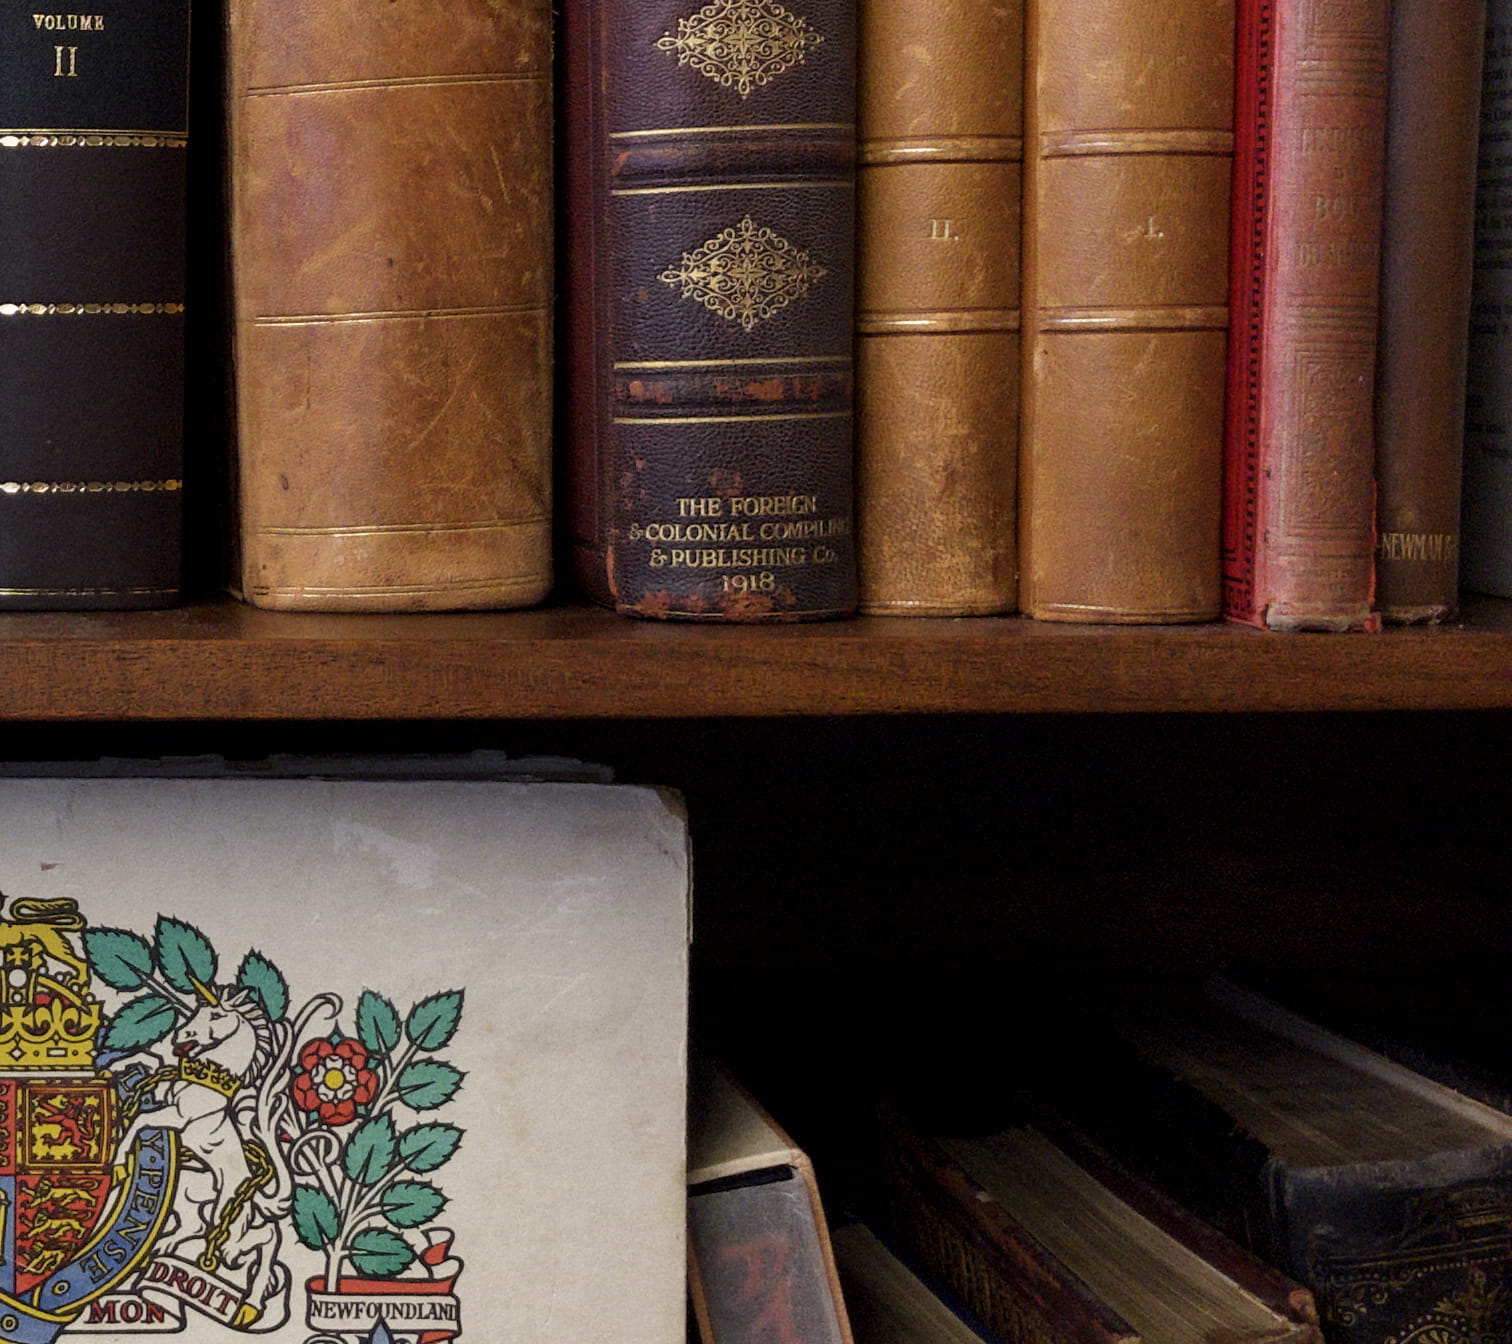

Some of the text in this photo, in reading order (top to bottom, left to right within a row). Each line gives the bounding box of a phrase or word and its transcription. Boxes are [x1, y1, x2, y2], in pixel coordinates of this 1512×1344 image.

[32, 13, 106, 33] VOLUME
[53, 45, 79, 78] II
[676, 495, 817, 518] THE FOREIGN
[645, 522, 755, 543] COLONIAL
[649, 547, 669, 568] &
[671, 546, 806, 569] PUBLISHING
[721, 571, 776, 593] 1918
[144, 1261, 239, 1317] DROIT
[83, 1298, 167, 1325] MON
